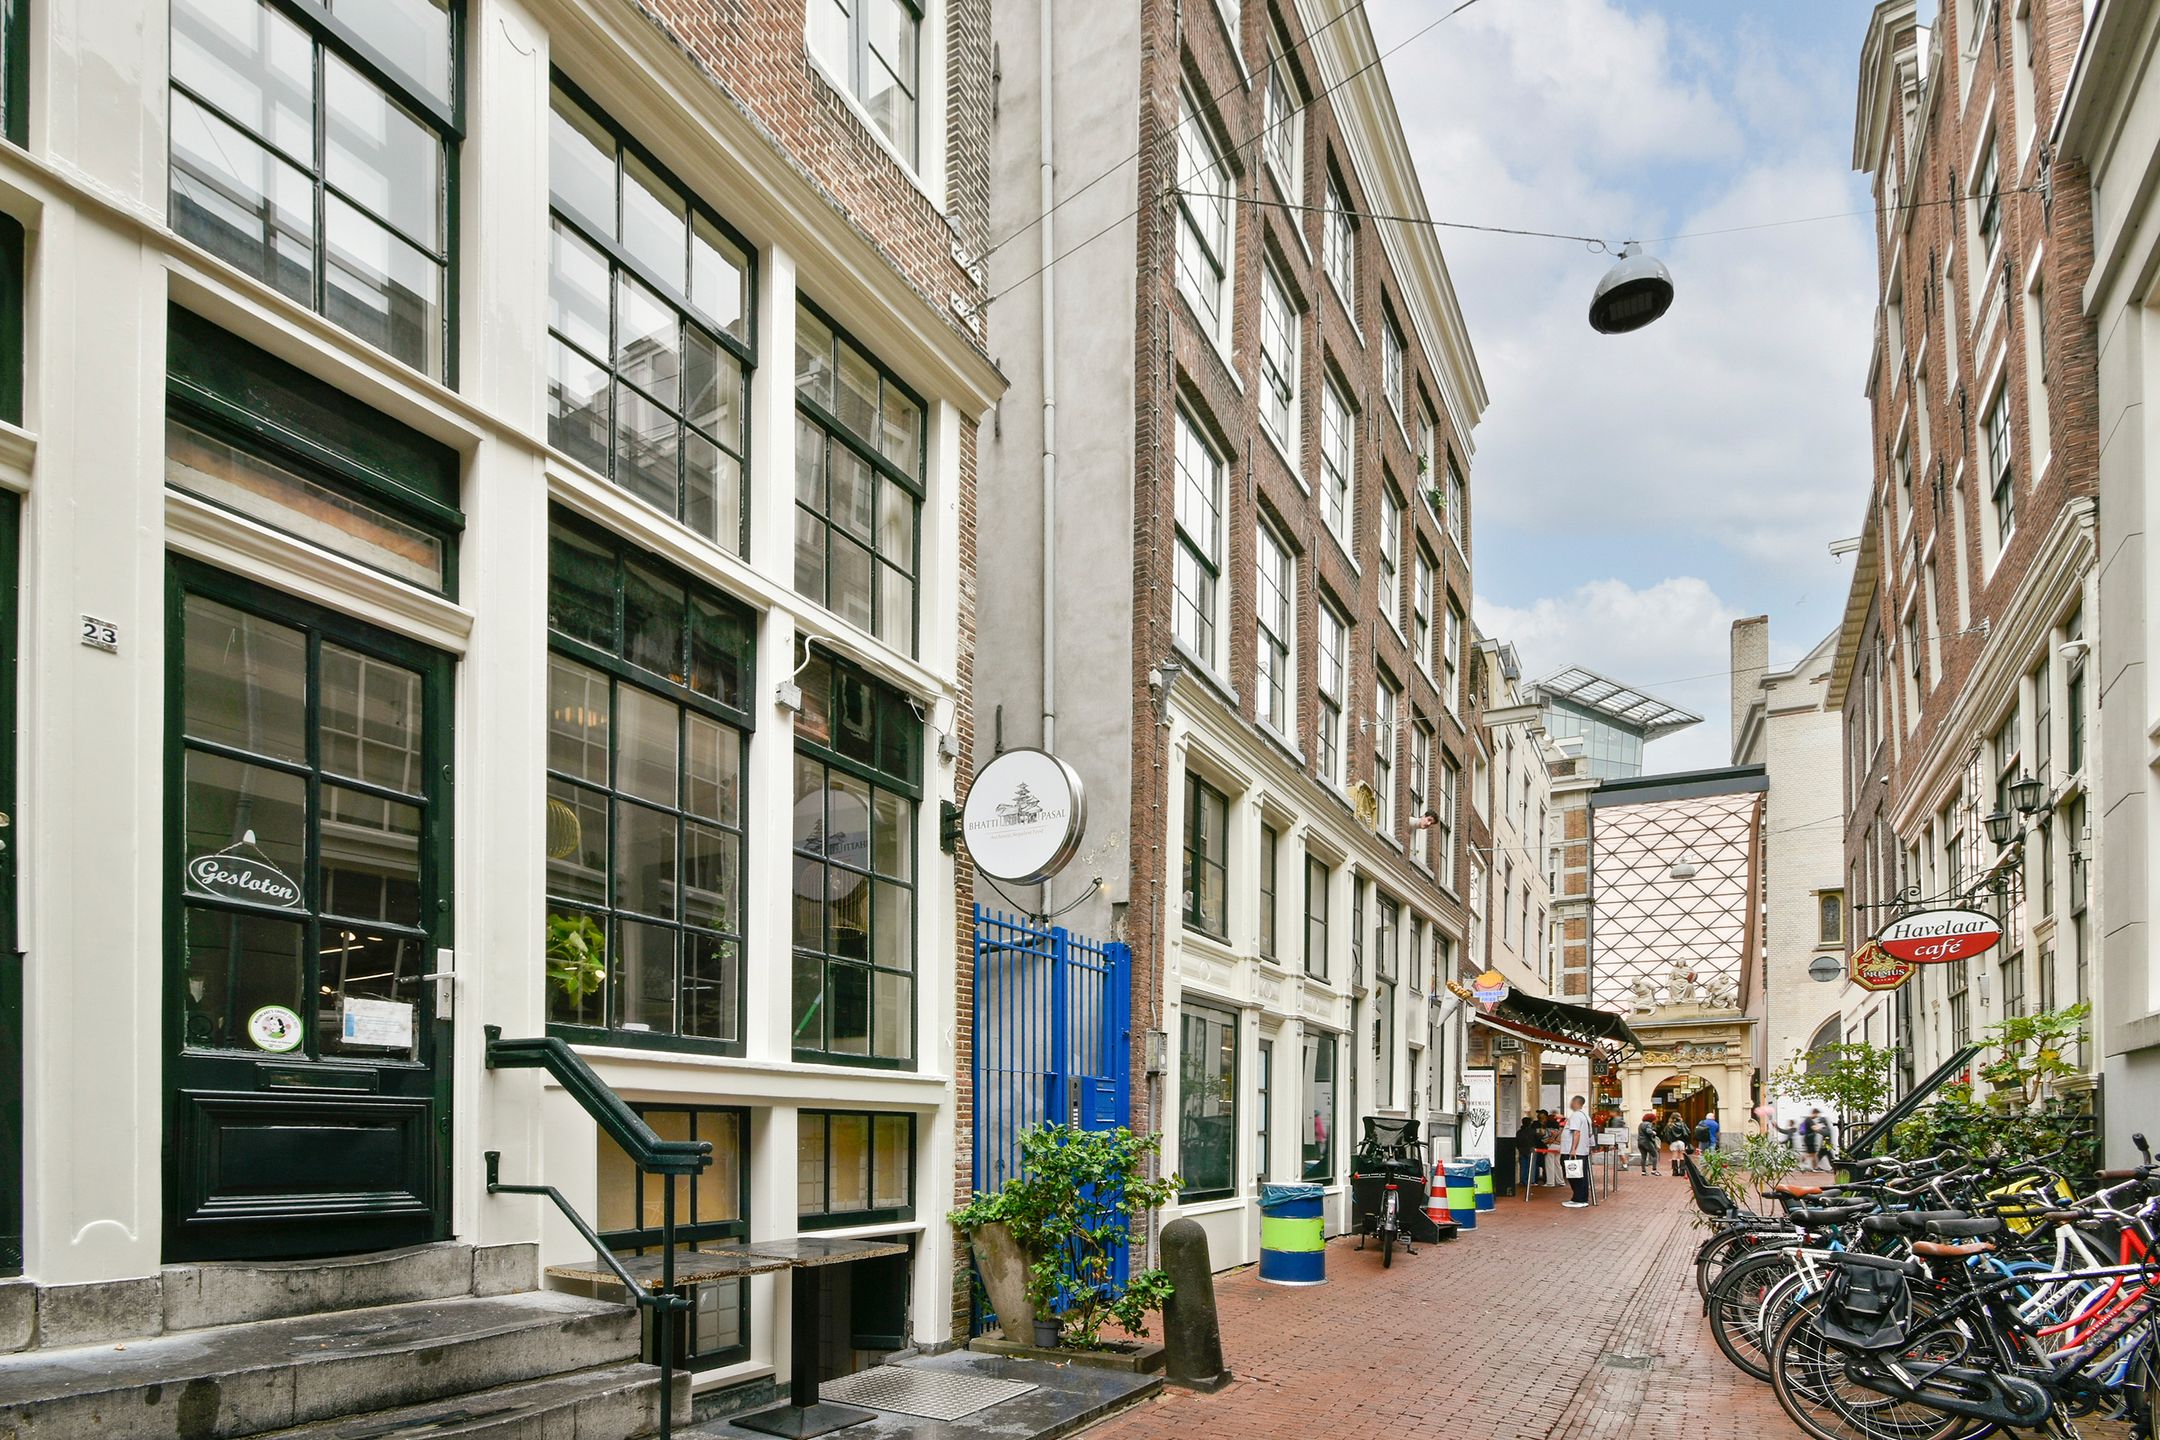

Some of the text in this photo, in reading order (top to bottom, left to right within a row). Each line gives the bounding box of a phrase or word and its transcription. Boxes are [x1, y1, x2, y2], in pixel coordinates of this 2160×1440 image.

[83, 623, 117, 644] 23
[969, 809, 1066, 830] BHATTI PASAL
[198, 860, 293, 899] Gesloten
[1893, 920, 1989, 938] Havelaar
[1914, 938, 1964, 960] café
[1863, 969, 1906, 978] PRIMUS
